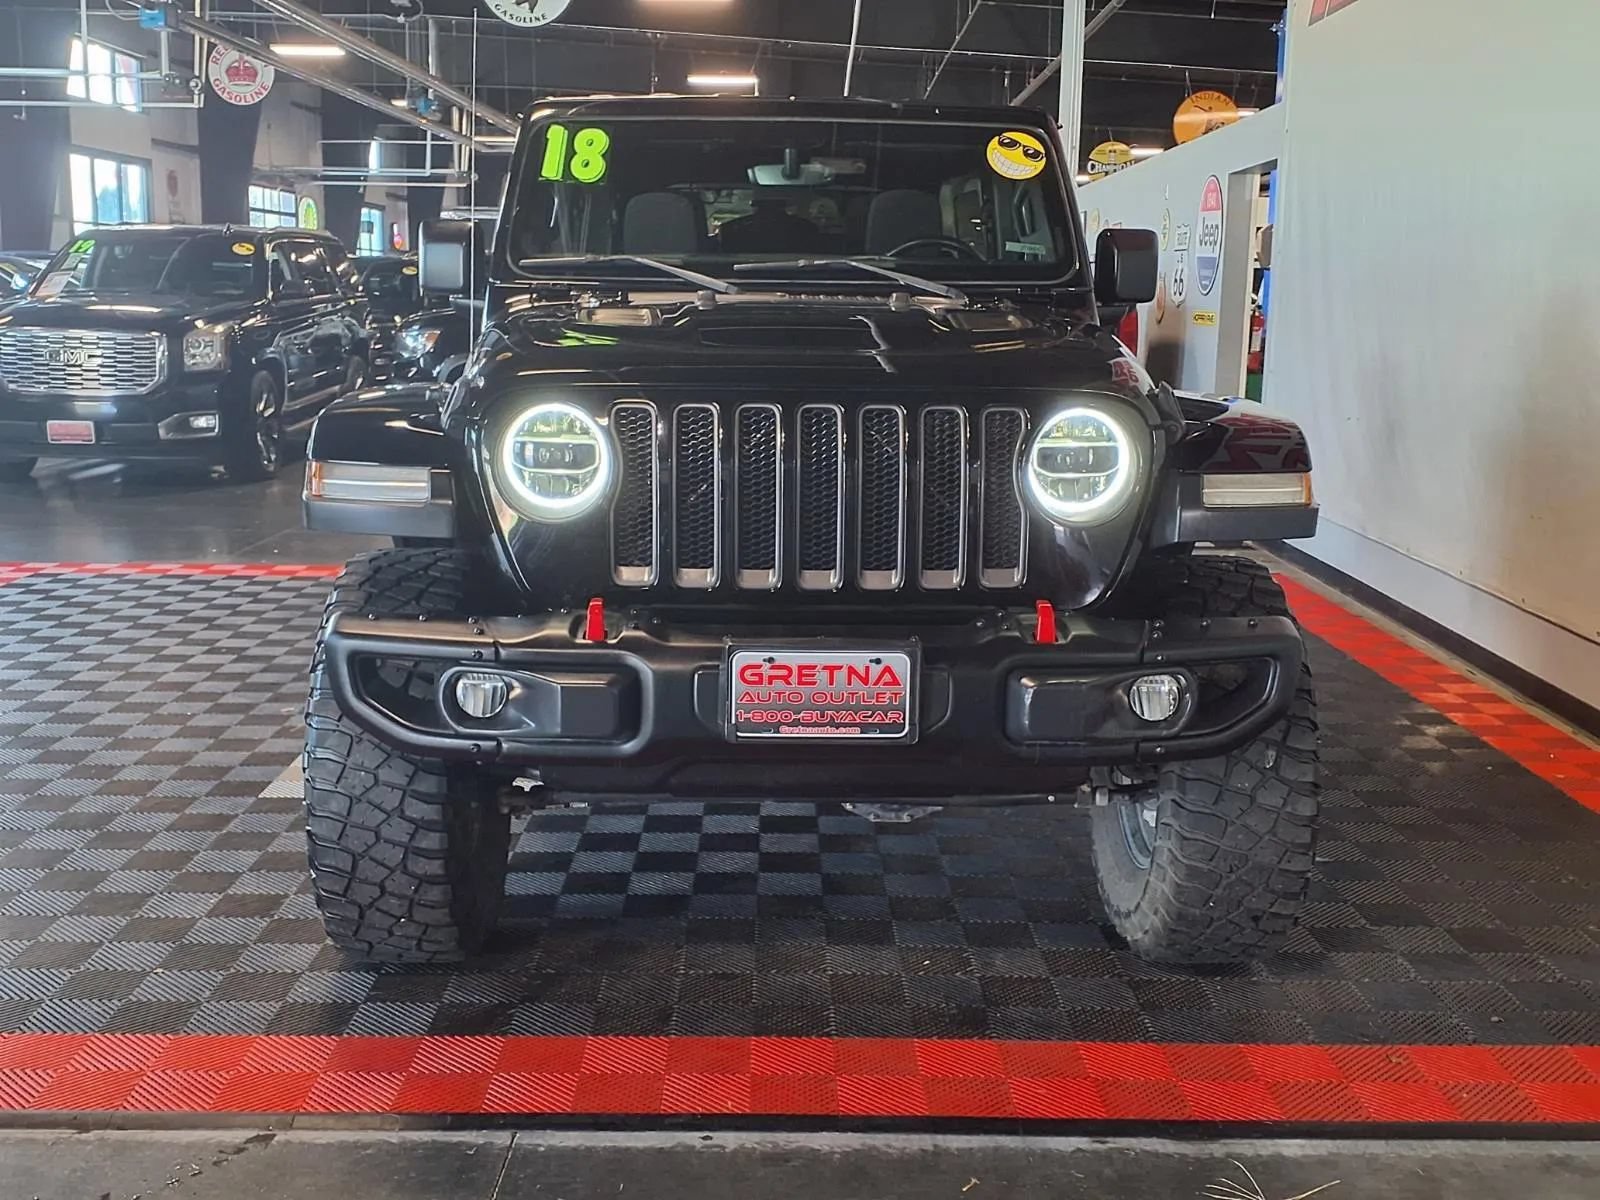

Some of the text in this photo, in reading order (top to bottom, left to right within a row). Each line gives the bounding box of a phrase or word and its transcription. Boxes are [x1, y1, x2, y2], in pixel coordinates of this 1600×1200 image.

[494, 3, 548, 23] GASOLINE
[212, 78, 270, 103] GASOLINE
[539, 124, 610, 183] 18
[1199, 216, 1219, 252] Jeep
[68, 239, 96, 253] 19
[1173, 267, 1184, 297] 66
[44, 348, 104, 364] GMC
[738, 663, 904, 688] GRETNA
[737, 691, 905, 705] AUTO OUTLET
[736, 709, 904, 723] 1-800-BUYACAR
